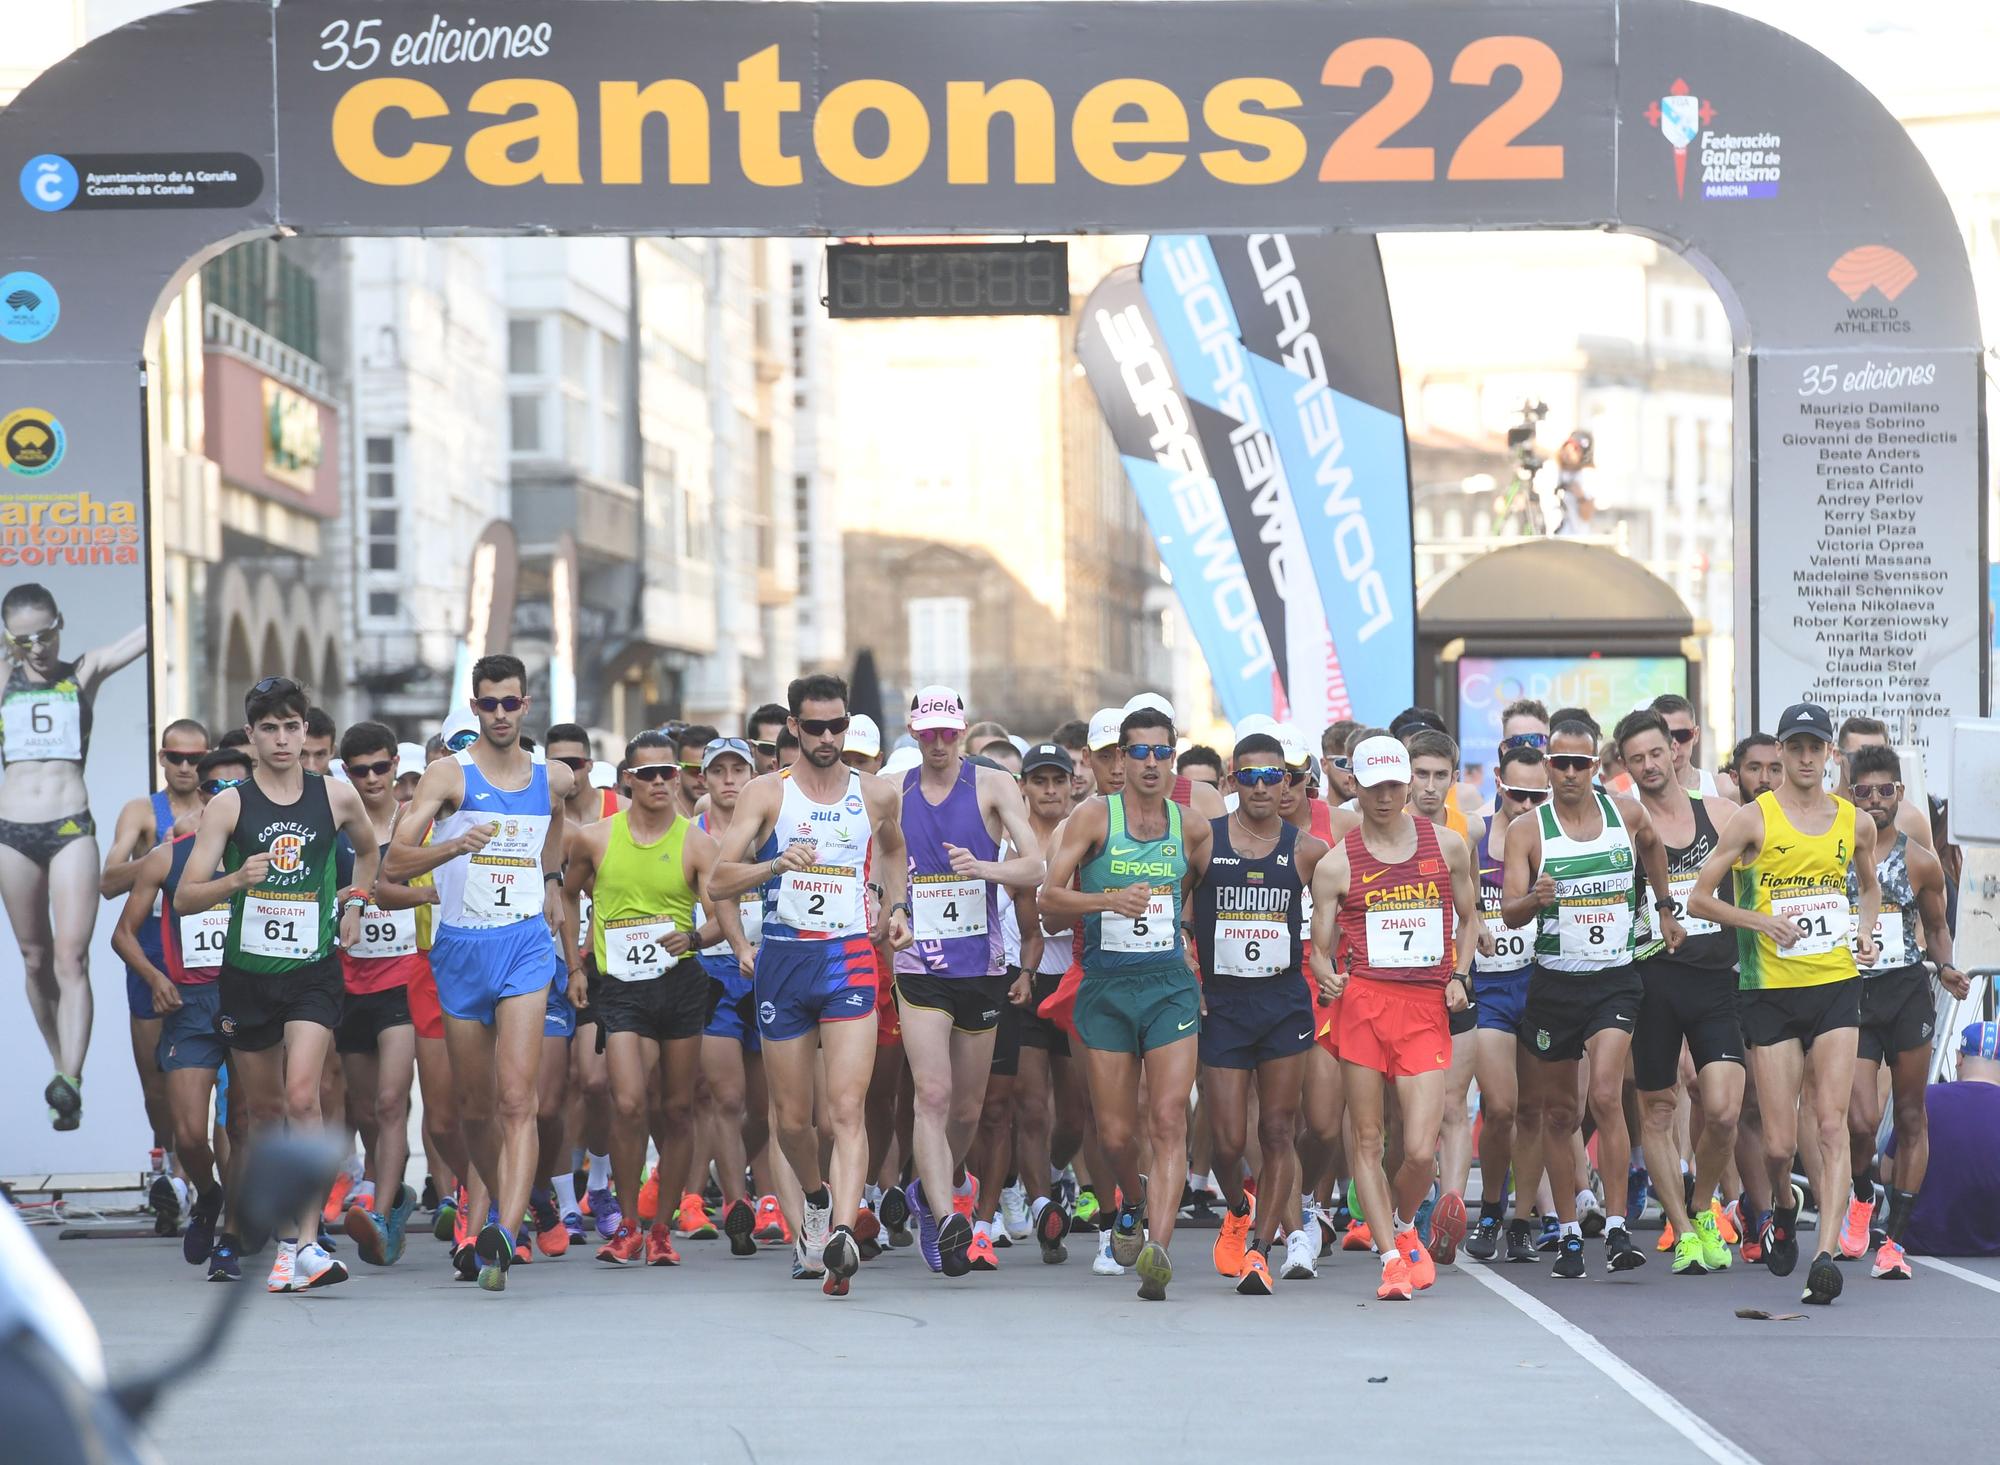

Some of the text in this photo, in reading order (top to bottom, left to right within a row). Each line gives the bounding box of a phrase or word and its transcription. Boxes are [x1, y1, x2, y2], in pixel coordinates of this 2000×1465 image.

[313, 14, 552, 70] 35 ediciones
[332, 36, 1564, 187] cantones22
[1701, 131, 1780, 149] Federación
[1701, 150, 1780, 170] Galega de
[86, 170, 237, 186] Ayuntamiento de A Coruña
[1702, 166, 1780, 182] Atletismo
[86, 183, 194, 196] Concello da Coruña
[1706, 185, 1749, 198] MARCHA
[1847, 308, 1898, 320] WORLD
[1834, 321, 1911, 333] ATHLETICS
[1798, 362, 1936, 396] 35 ediciones
[1800, 402, 1940, 415] Maurizio Damilano
[1815, 417, 1926, 431] Reyes Sobrino
[1782, 432, 1958, 446] Giovanni de Benedictis
[1819, 448, 1921, 460] Beate Anders
[1816, 463, 1924, 475] Ernesto Canto
[1826, 479, 1864, 490] Erica
[1817, 493, 1924, 507] Andrey Perlov
[0, 492, 138, 524] archa
[1825, 509, 1916, 522] Kerry Saxby
[0, 525, 139, 546] ntones
[1825, 524, 1917, 536] Daniel Plaza
[1817, 539, 1924, 552] Victoria Oprea
[1865, 555, 1932, 566] Massana
[1793, 569, 1949, 582] Madeleine Svensson
[1798, 585, 1850, 597] Mikhail
[1807, 600, 1935, 612] Yelena Nikolaeva
[1793, 615, 1949, 628] Rober Korzeniowsky
[1815, 630, 1927, 643] Annarita Sidoti
[1828, 646, 1914, 659] Ilya Markov
[1825, 661, 1917, 673] Claudia Stef
[1812, 674, 1930, 688] Jefferson Pérez
[1801, 690, 1942, 706] Olimpiada Ivanova
[920, 698, 957, 715] ciele
[1828, 706, 1951, 718] cisco Fernández
[31, 703, 53, 733] 6
[1367, 755, 1401, 765] CHINA
[810, 811, 841, 822] aula
[470, 855, 535, 867] cantones22
[1212, 857, 1240, 866] emov
[1111, 859, 1177, 878] BRASIL
[490, 873, 515, 885] TUR
[793, 880, 843, 894] MARTÍN
[916, 888, 980, 898] DUNFEE, Evan
[247, 889, 317, 901] cantones22
[494, 886, 511, 907] 1
[1216, 886, 1291, 911] ECUADOR
[1364, 881, 1440, 907] CHINA
[257, 905, 306, 916] MCGRATH
[808, 895, 825, 915] 2
[943, 902, 959, 921] 4
[1780, 901, 1838, 915] FORTUNATO
[1217, 911, 1287, 922] cantones22
[1574, 912, 1615, 924] VIEIRA
[1133, 916, 1149, 936] 5
[1381, 917, 1427, 930] ZHANG
[1796, 916, 1832, 937] 91
[264, 919, 299, 943] 61
[365, 923, 396, 943] 99
[626, 931, 650, 941] SOTO
[1224, 928, 1279, 940] PINTADO
[1589, 925, 1605, 945] 8
[1399, 930, 1414, 951] 7
[1495, 936, 1524, 956] 60
[627, 944, 658, 965] 42
[1245, 941, 1261, 961] 6
